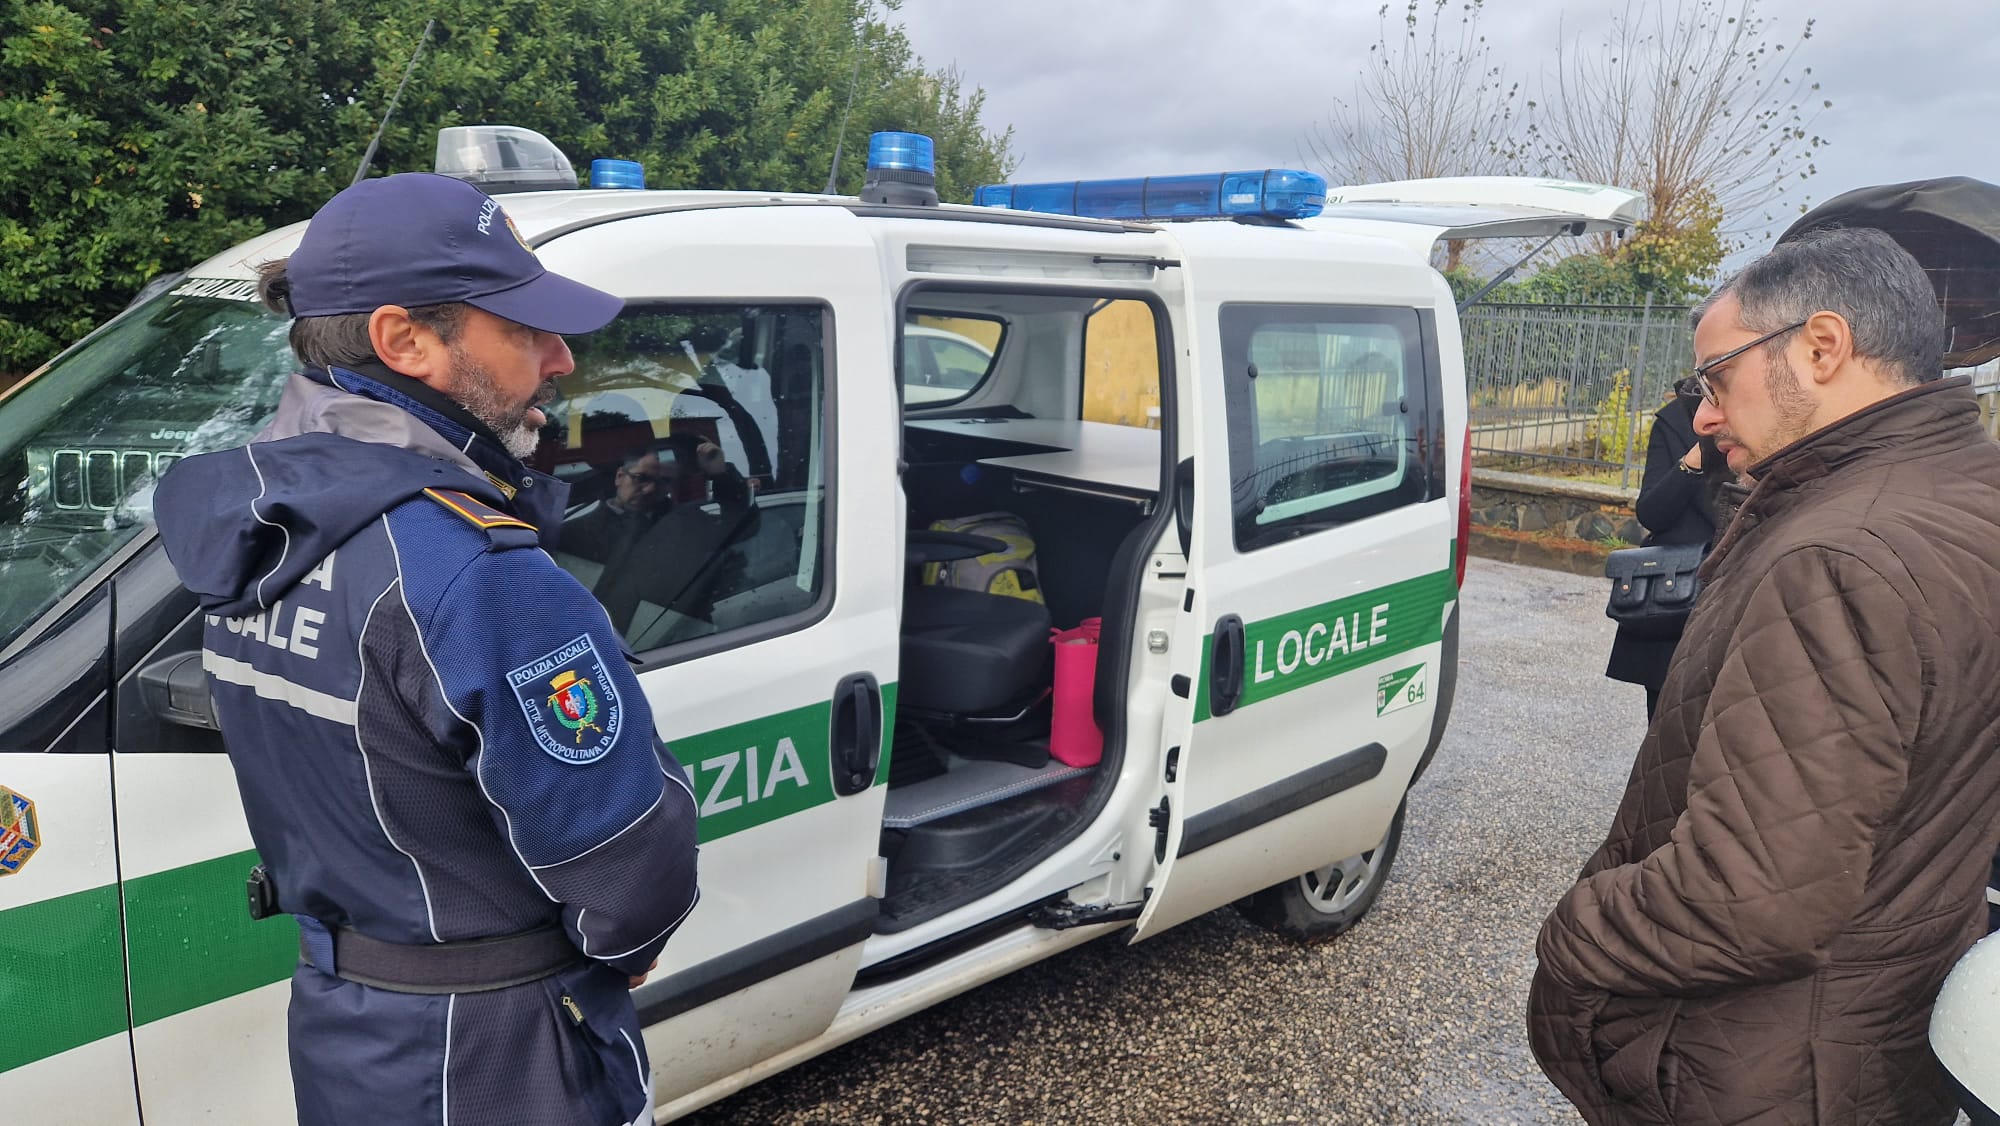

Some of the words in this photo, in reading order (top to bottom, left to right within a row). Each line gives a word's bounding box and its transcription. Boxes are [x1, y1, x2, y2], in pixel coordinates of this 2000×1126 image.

[150, 427, 199, 442] Jeep
[1254, 602, 1389, 684] LOCALE
[514, 661, 554, 684] POLIZIA
[555, 640, 588, 664] LOCALE
[592, 664, 614, 700] CAPITALE
[1407, 681, 1424, 703] 64
[606, 705, 618, 734] ROMA
[536, 725, 602, 759] METROPOLITANA
[600, 736, 609, 746] DI
